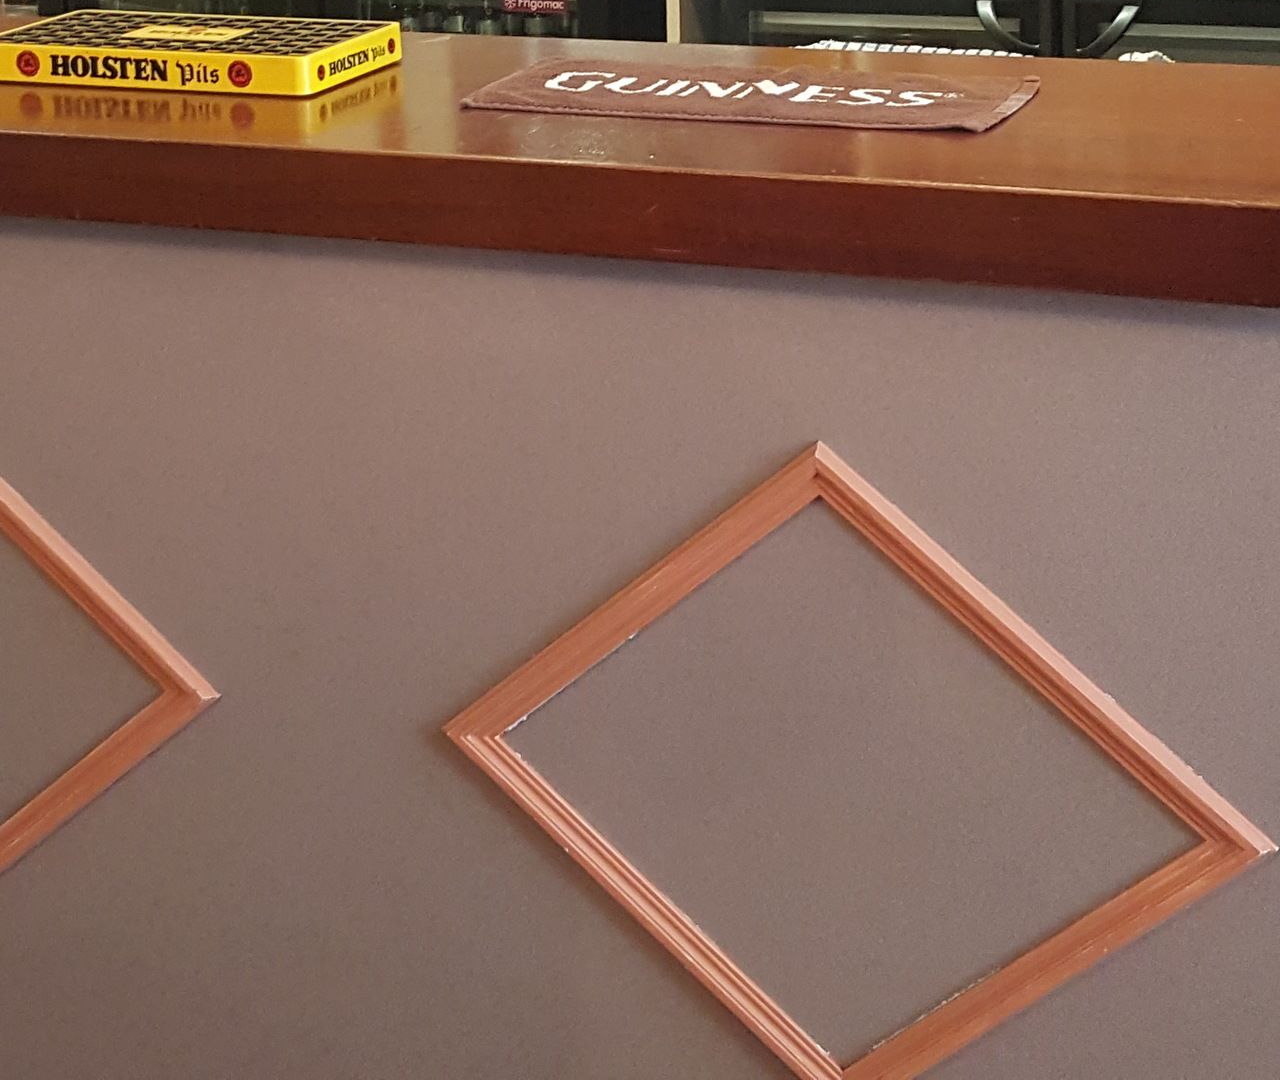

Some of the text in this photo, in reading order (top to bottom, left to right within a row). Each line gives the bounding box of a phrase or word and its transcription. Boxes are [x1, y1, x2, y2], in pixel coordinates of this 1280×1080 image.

[49, 53, 168, 83] HOLSTEN
[328, 48, 369, 77] HOLSTEN
[544, 70, 954, 107] GUINNESS
